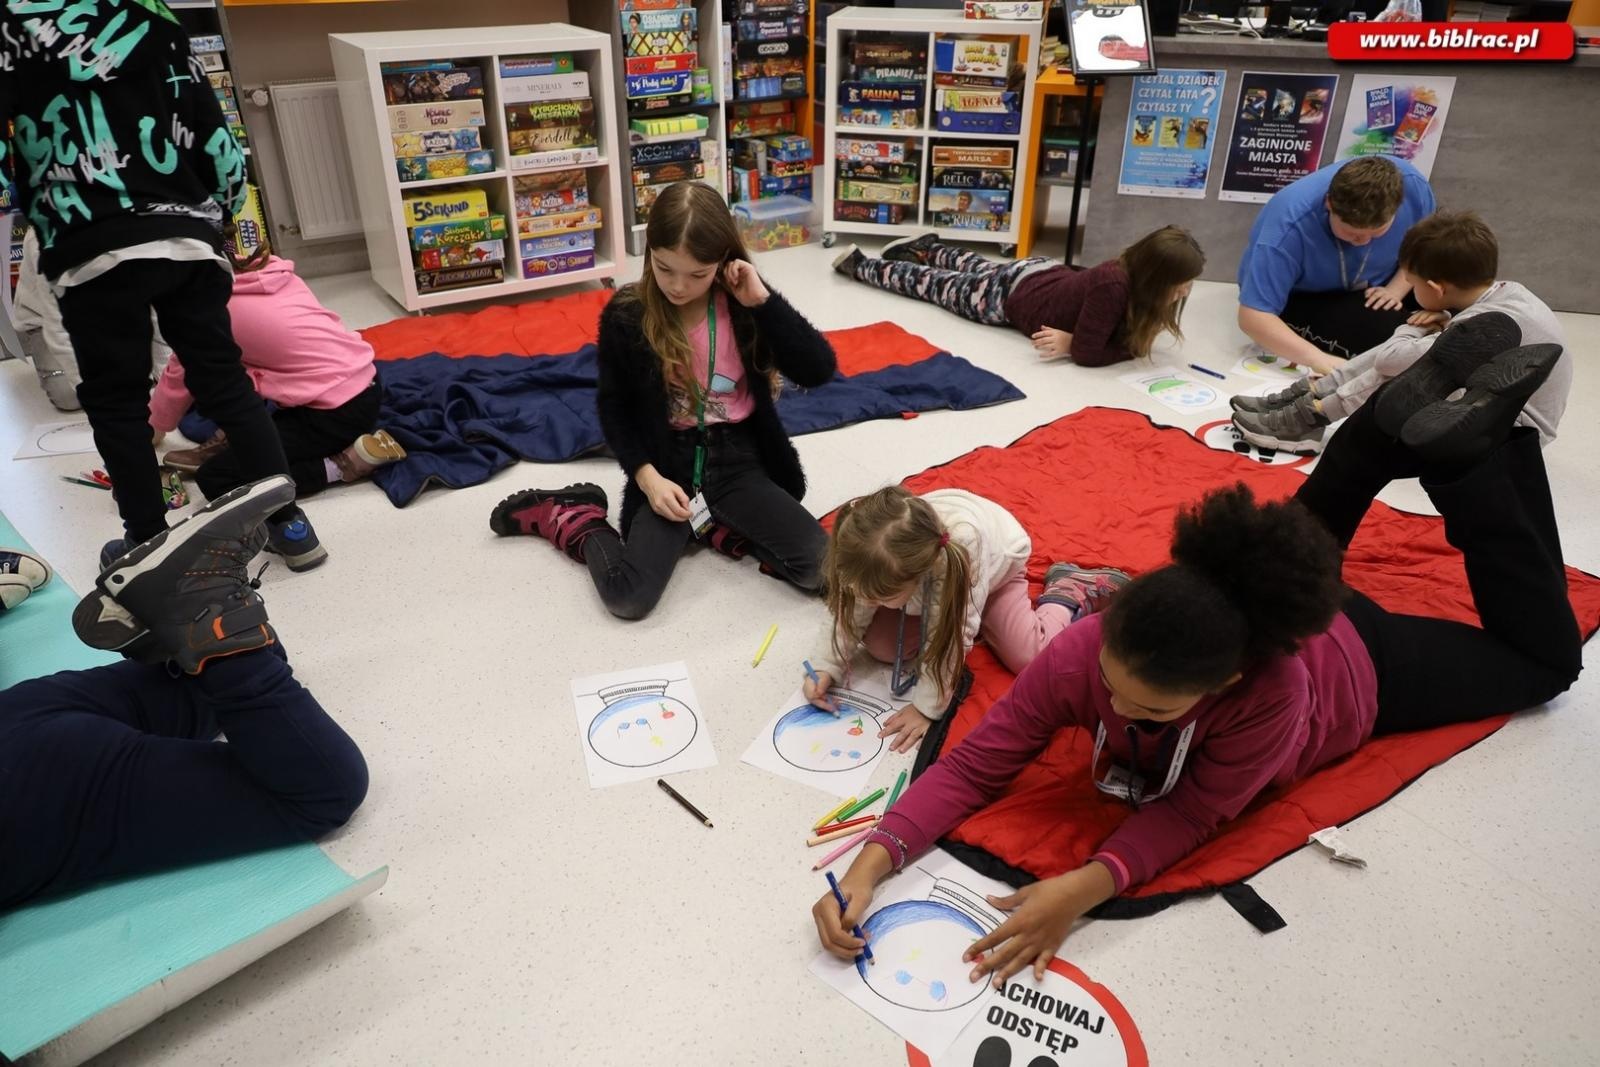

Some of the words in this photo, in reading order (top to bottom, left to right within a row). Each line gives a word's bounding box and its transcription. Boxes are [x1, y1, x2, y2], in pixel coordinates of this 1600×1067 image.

[1177, 75, 1221, 86] DZIADEK
[861, 88, 900, 99] FAUNA
[1175, 89, 1199, 99] TATA
[1136, 102, 1178, 113] CZYTASZ
[1180, 103, 1192, 113] TY
[1240, 136, 1312, 151] ZAGINIONE
[1248, 151, 1297, 164] MIASTA
[943, 174, 974, 186] RELIC
[413, 201, 427, 222] 5
[996, 979, 1105, 1035] ACHOWAJ
[987, 1005, 1079, 1055] ODSTĘP
